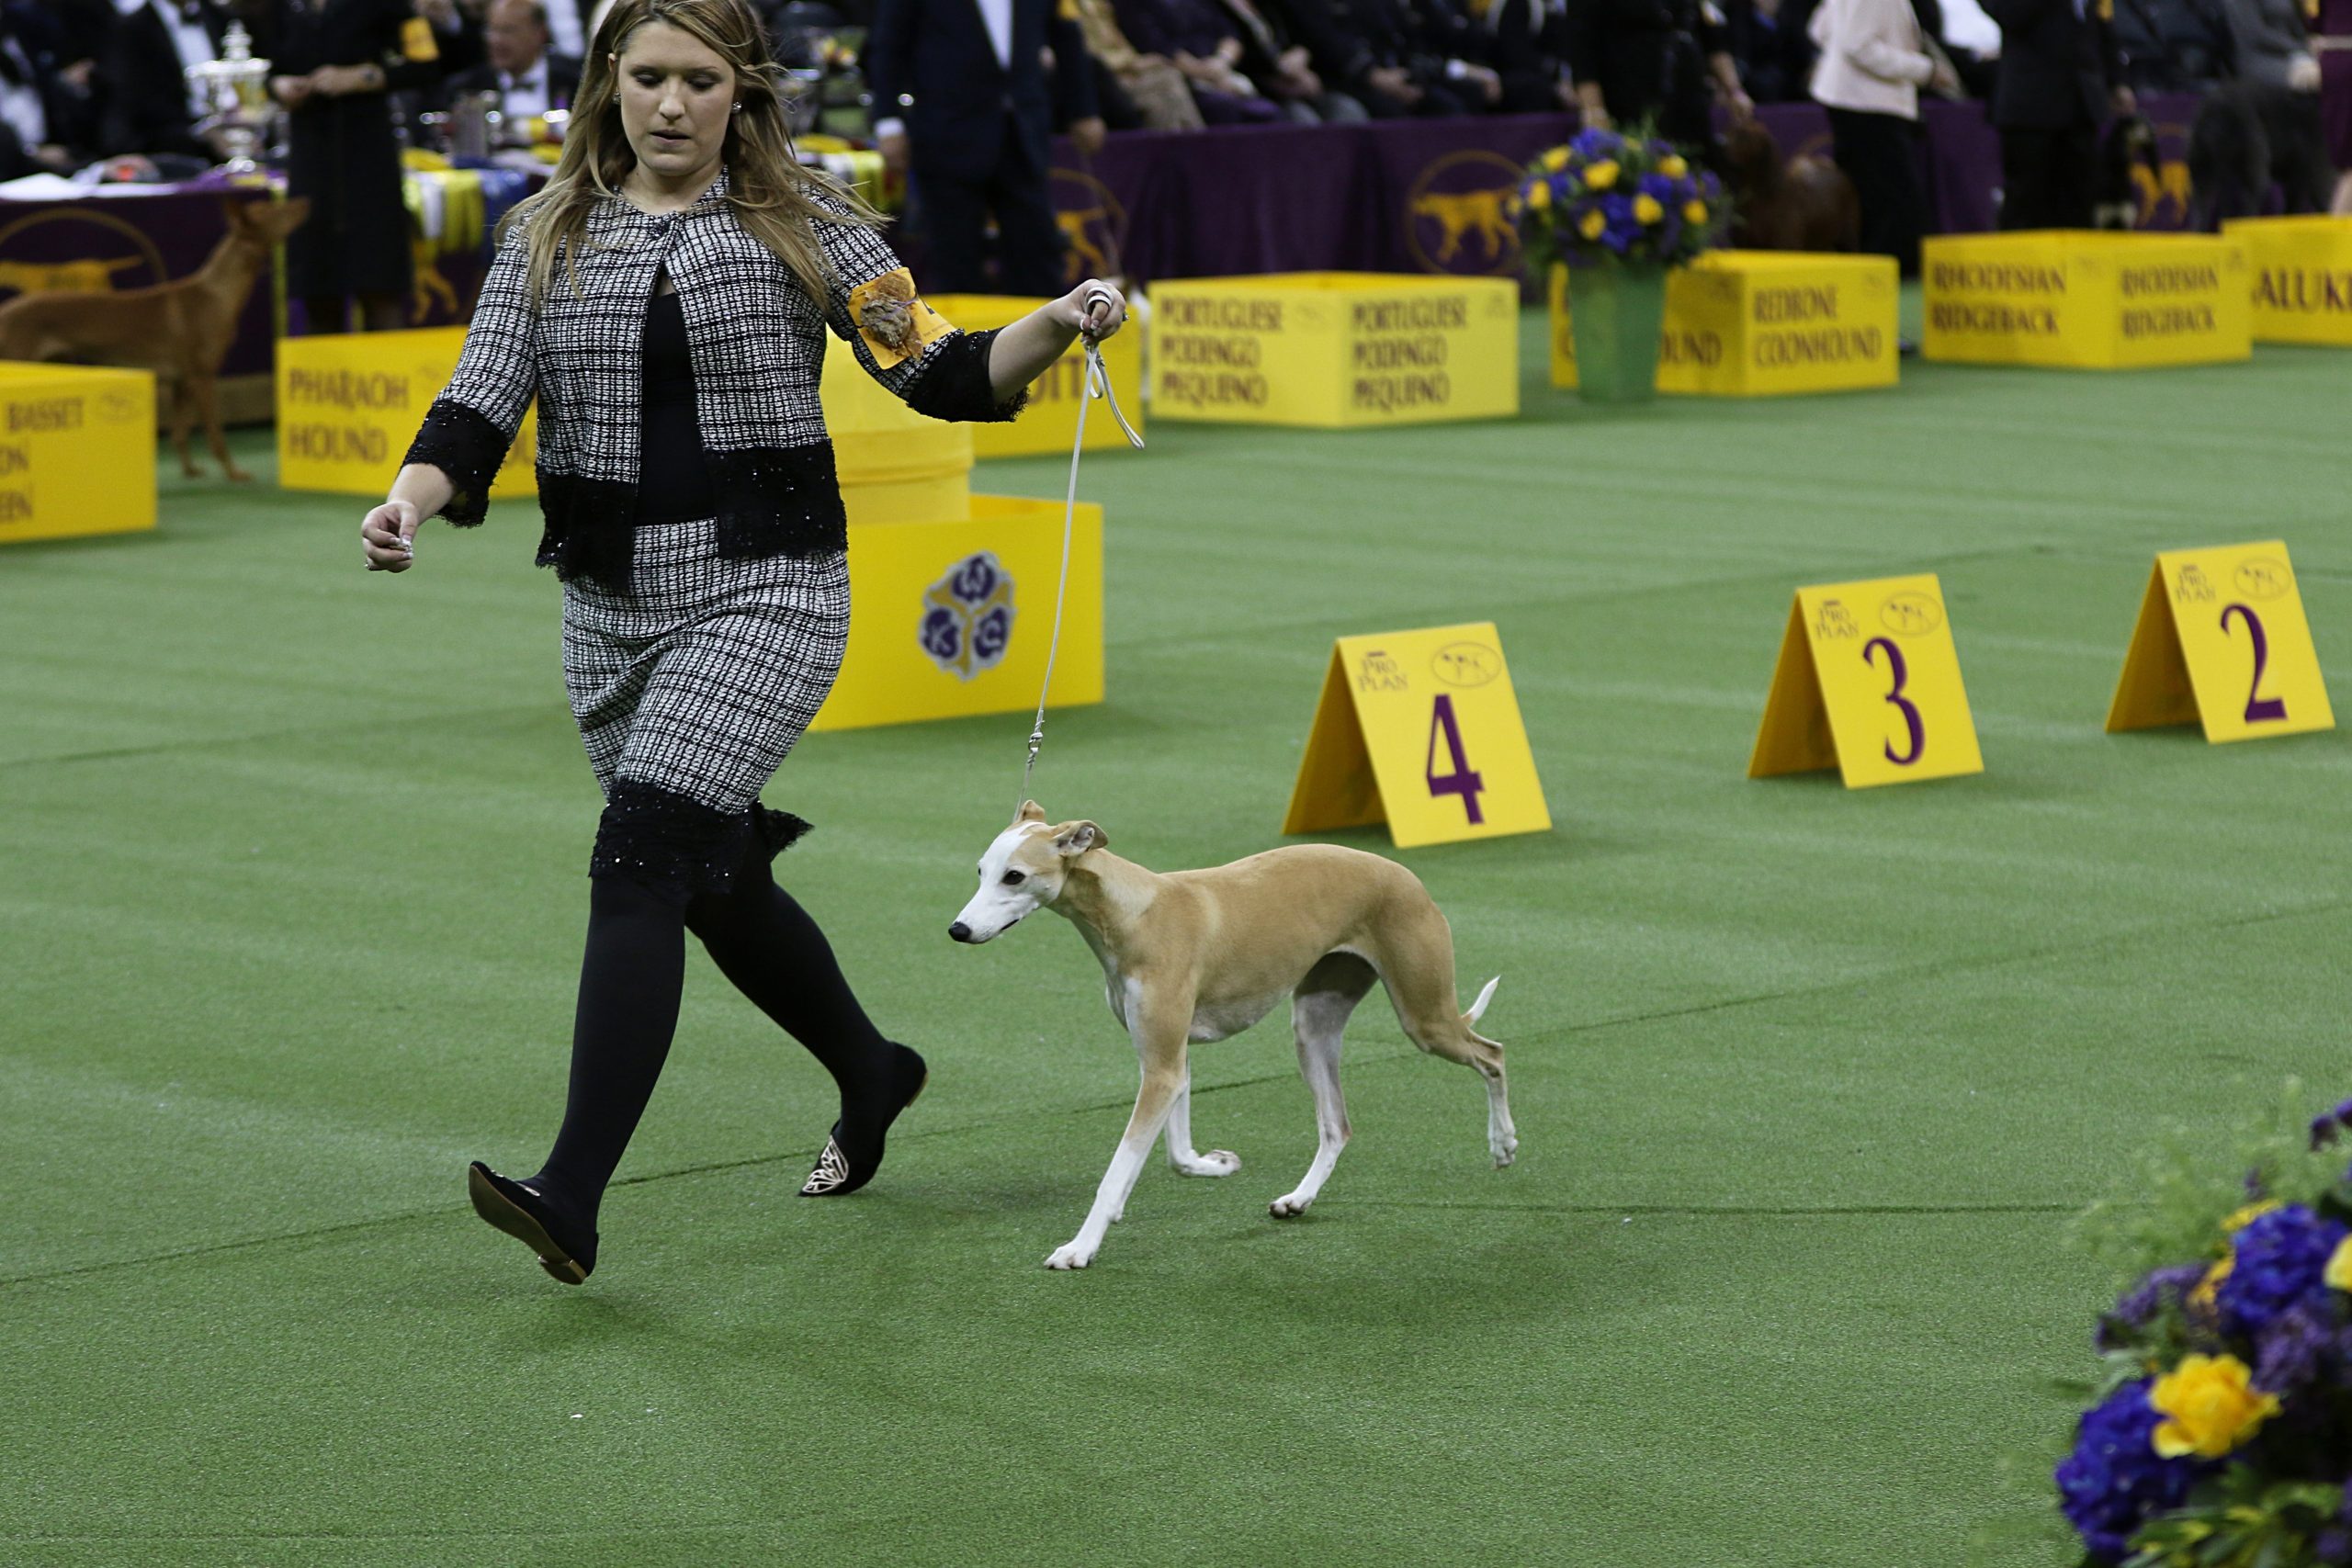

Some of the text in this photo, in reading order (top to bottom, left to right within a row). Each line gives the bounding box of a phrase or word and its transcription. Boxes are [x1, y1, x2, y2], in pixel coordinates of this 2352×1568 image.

[1932, 261, 2067, 295] RHODESIAN
[2121, 264, 2219, 299] RHODESIAN
[1160, 294, 1283, 332] PORTUGUESE
[1352, 294, 1467, 333] PORTUGUESE
[1754, 285, 1838, 323] REDBONE
[1932, 299, 2061, 336] RIDGEBACK
[2121, 303, 2218, 340] RIDGEBACK
[1160, 333, 1262, 369] PODENGO
[1352, 333, 1449, 371] PODENGO
[1754, 324, 1883, 369] COONHOUND
[288, 367, 410, 412] PHARAOH
[1161, 369, 1269, 408] PEQUENO
[1352, 369, 1451, 414] PEQUENO
[7, 396, 85, 434] BASSET
[288, 423, 390, 464] HOUND
[1362, 656, 1398, 676] PRO
[2220, 602, 2289, 725] 2
[1357, 673, 1409, 693] PLAN
[1861, 636, 1926, 767] 3
[1426, 693, 1486, 825] 4
